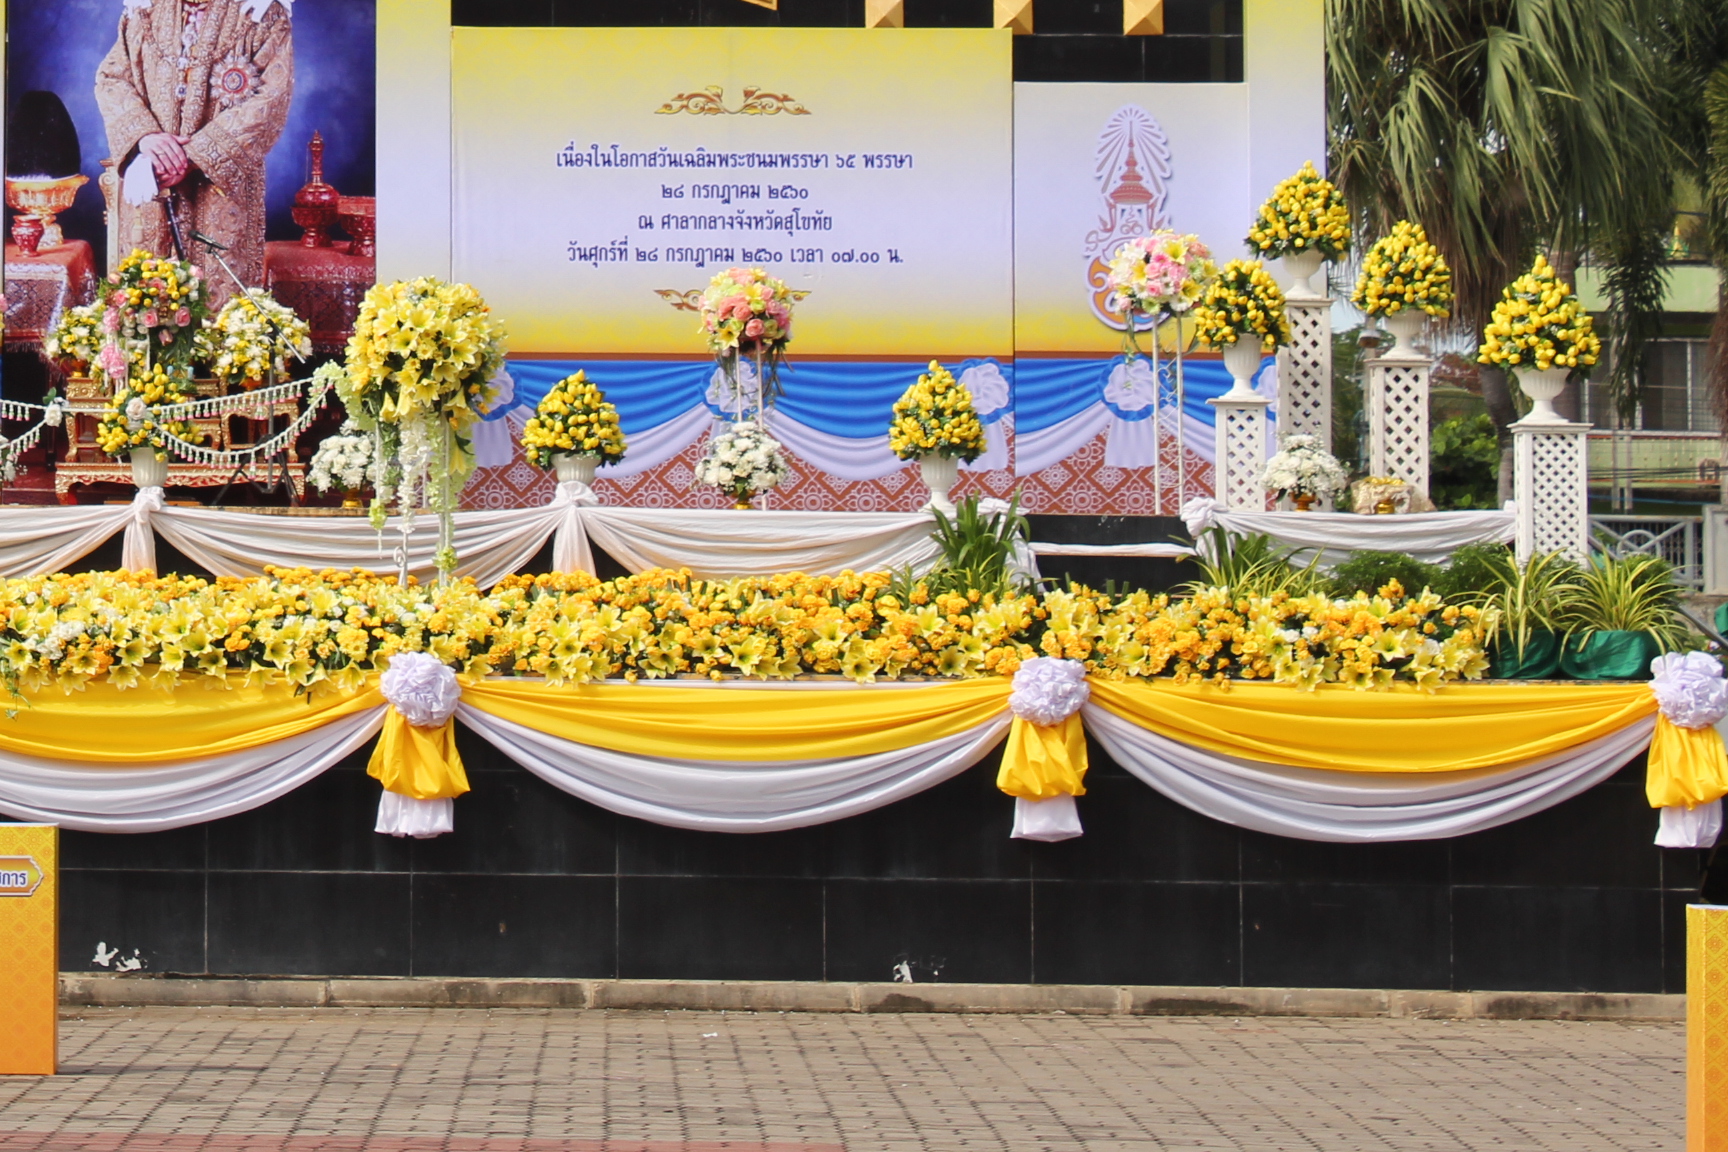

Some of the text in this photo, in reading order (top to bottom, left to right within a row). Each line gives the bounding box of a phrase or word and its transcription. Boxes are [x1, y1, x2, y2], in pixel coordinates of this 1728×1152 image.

[556, 141, 913, 169] เนื่องในโอกาสวันเฉลิมพระชนมพรรษา ๖๕ พรรษา
[661, 184, 809, 205] ๒๘ กรกฎาคม ๒๕๖๐
[638, 207, 833, 237] ณ ศาลากลางจังหวัดสุโขทัย
[567, 235, 904, 268] วันศุกร์ที่ ๒๘ กรกฎาคม ๒๕๖๐ เวลา ๐๗.๐๐ น.
